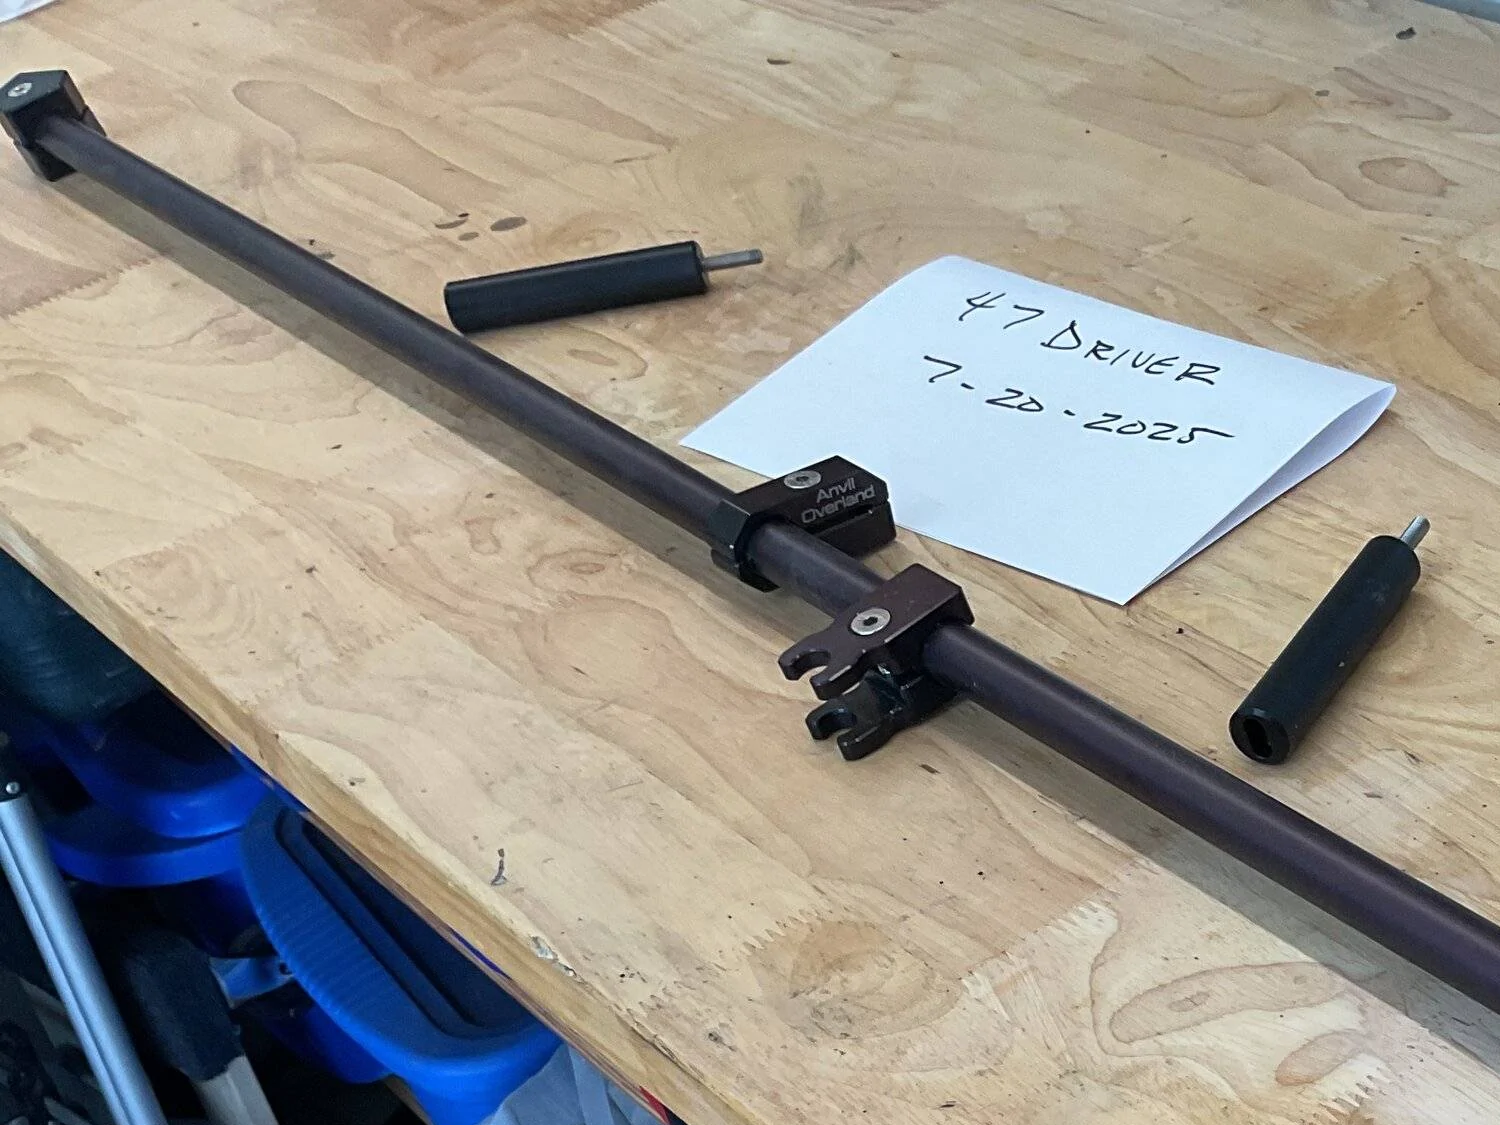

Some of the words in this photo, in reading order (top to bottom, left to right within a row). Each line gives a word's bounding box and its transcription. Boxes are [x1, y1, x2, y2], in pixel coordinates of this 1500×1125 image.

[1039, 319, 1222, 386] DRIVER
[801, 484, 876, 524] Overland
[815, 477, 857, 503] Anvil
